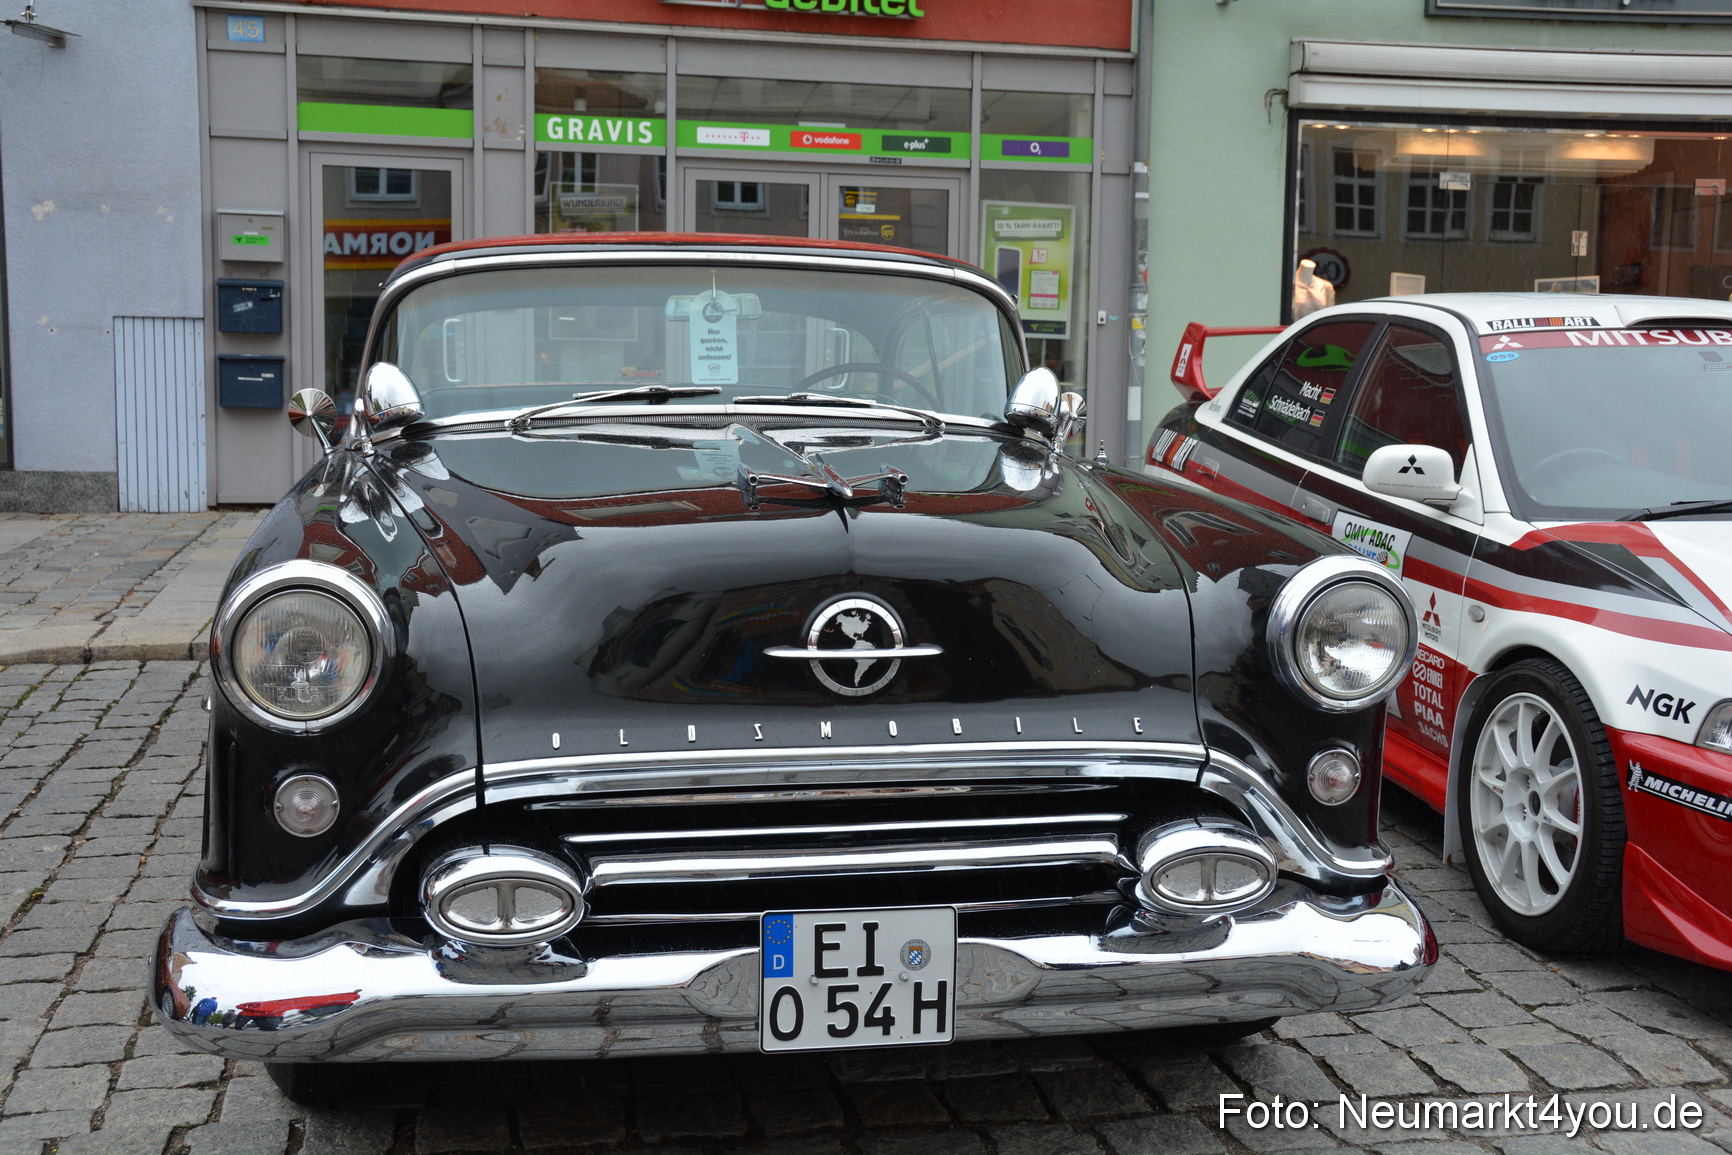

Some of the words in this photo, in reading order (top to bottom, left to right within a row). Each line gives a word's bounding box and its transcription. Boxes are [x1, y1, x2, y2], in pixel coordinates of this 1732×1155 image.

[232, 20, 260, 38] 45
[546, 116, 654, 144] GRAVIS
[813, 135, 850, 146] vodafone
[562, 199, 625, 208] WUNDERKIND!
[1492, 318, 1535, 331] RALLI
[1564, 316, 1594, 327] ART
[1299, 381, 1322, 401] Macht
[1268, 394, 1311, 422] Schnädelbach
[1344, 521, 1369, 543] OMV
[1368, 529, 1396, 552] ADAC
[1421, 622, 1441, 636] MITSUBISHI
[1424, 631, 1439, 643] MOTORS
[1415, 648, 1445, 670] RECARO
[1426, 667, 1443, 690] ENKEI
[1412, 681, 1444, 710] TOTAL
[1626, 683, 1696, 724] NGK
[1414, 701, 1445, 730] PIAA
[552, 717, 1144, 749] OLDSMOBILE
[1418, 720, 1449, 748] SACHS
[814, 921, 885, 978] EI
[772, 954, 785, 970] D
